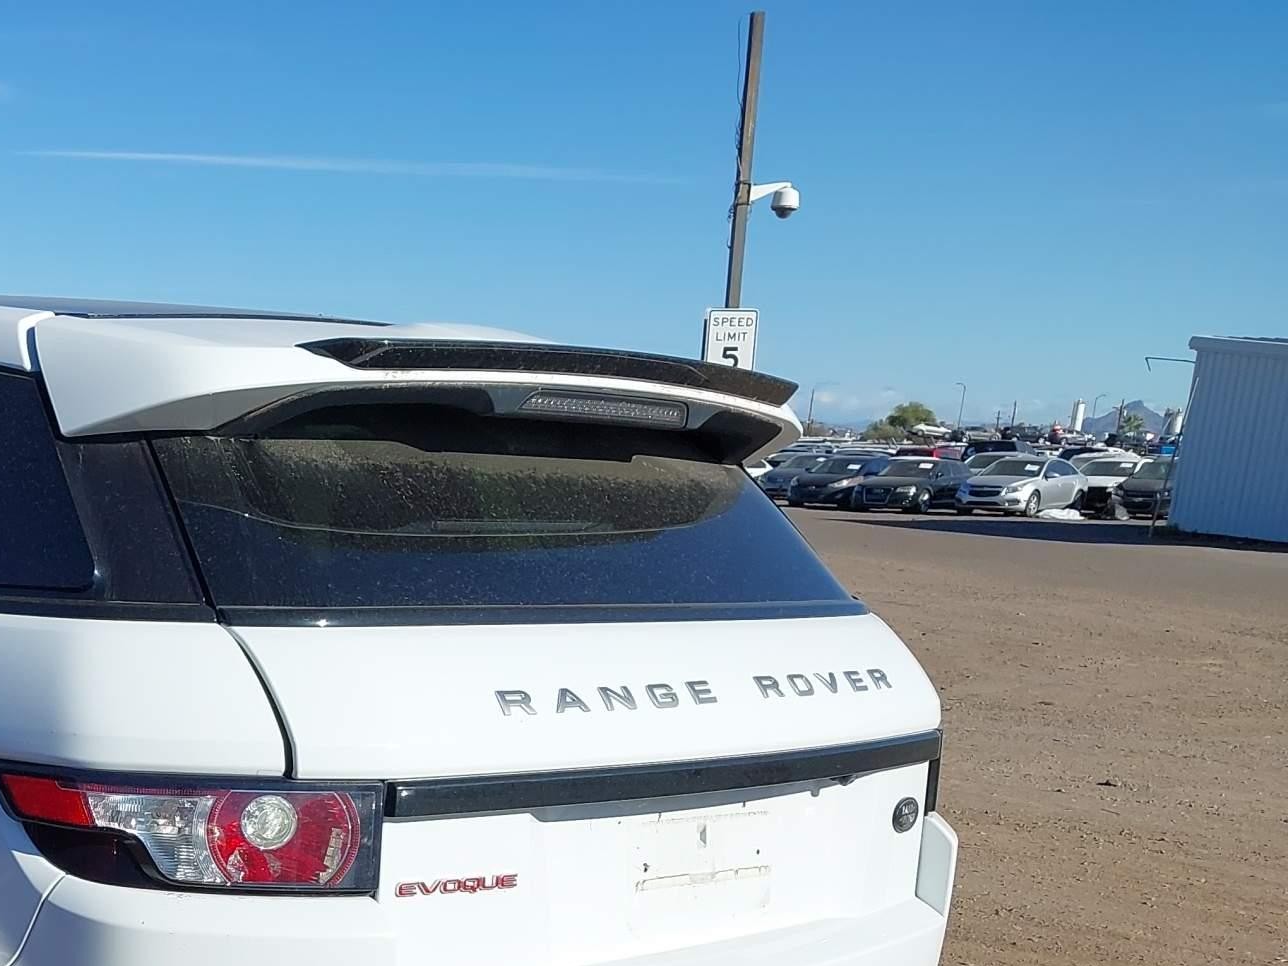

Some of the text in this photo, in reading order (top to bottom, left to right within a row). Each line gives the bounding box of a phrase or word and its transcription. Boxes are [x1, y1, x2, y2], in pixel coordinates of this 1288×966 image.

[712, 316, 754, 327] SPEED
[715, 331, 748, 342] LIMIT
[721, 346, 739, 368] 5
[494, 668, 893, 717] RANGE ROVER
[395, 874, 518, 898] EVOQUE
